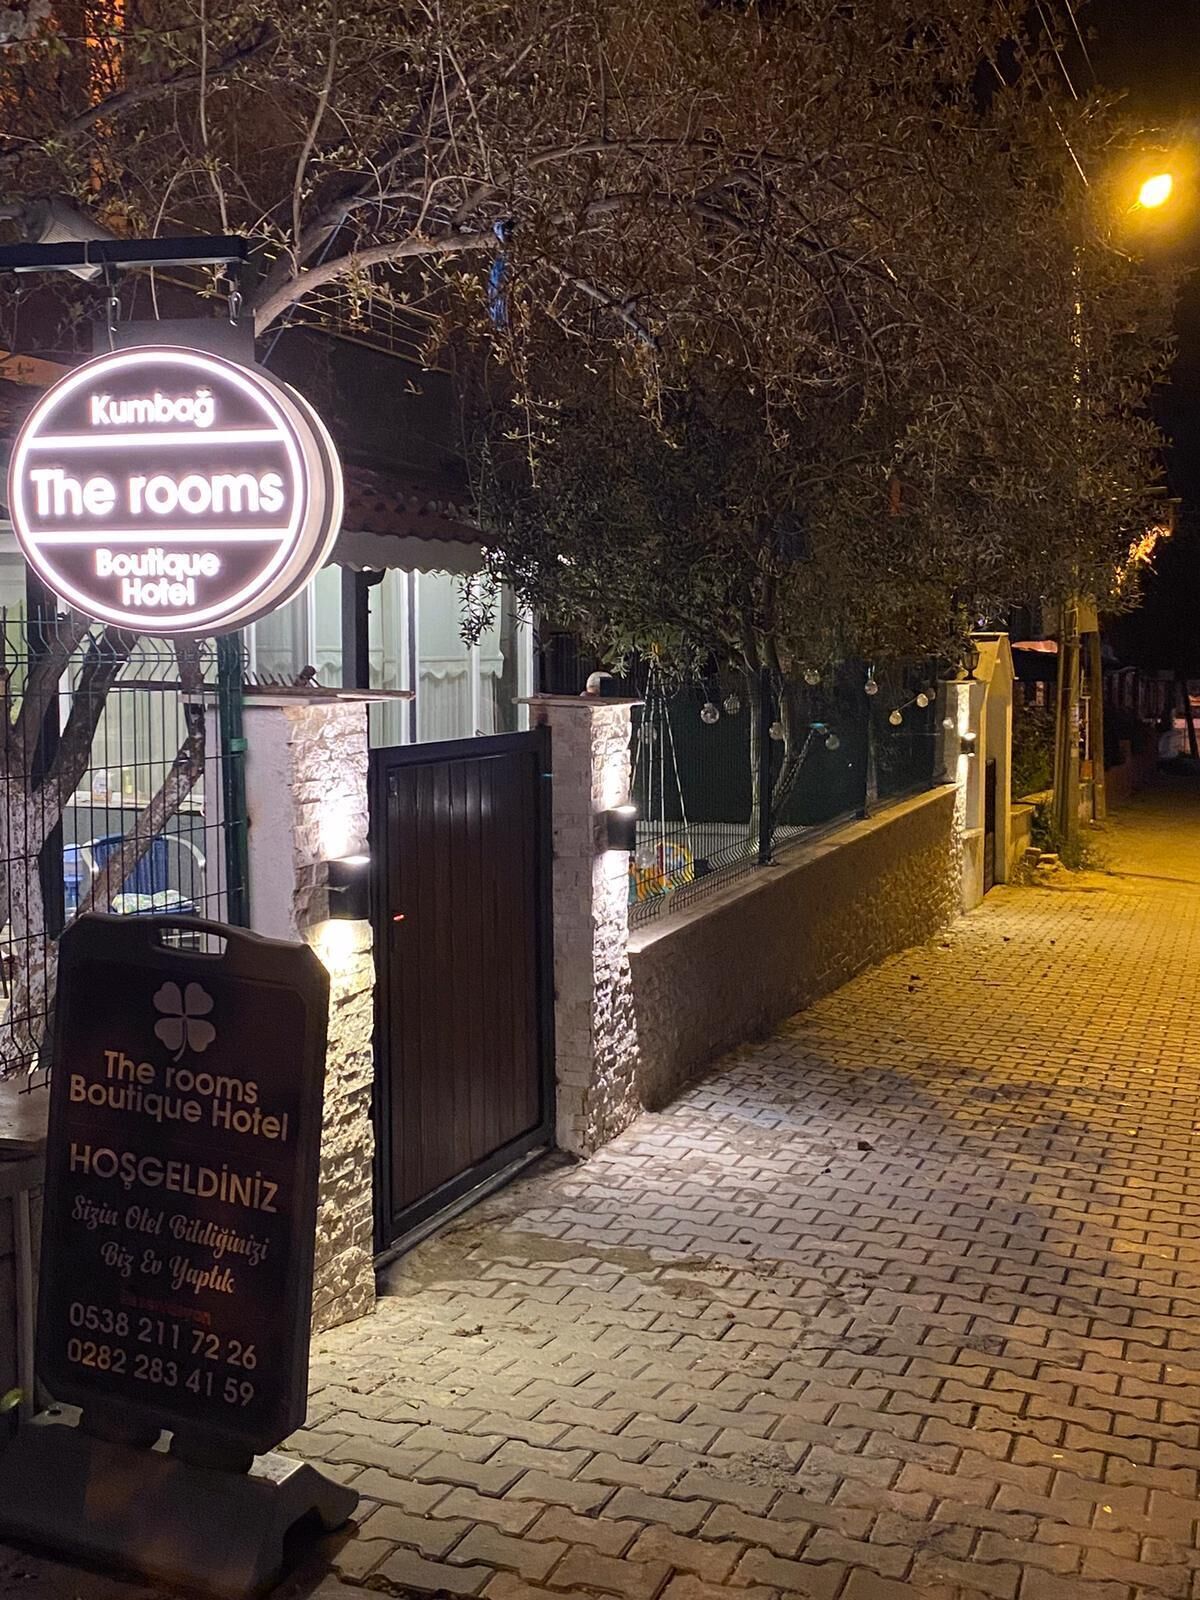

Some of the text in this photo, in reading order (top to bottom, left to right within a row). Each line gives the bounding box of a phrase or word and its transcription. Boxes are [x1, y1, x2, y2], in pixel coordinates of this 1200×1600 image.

[91, 388, 214, 428] Kumbağ
[30, 468, 284, 516] The rooms
[95, 547, 221, 580] Boutique
[122, 577, 196, 606] Hotel
[104, 1050, 258, 1103] The rooms
[70, 1074, 288, 1141] Boutique Hotel
[70, 1143, 279, 1213] HOŞGELDİNİZ
[71, 1195, 270, 1265] Sizin Otel Bildiğinizi
[101, 1241, 235, 1294] Biz Ev Yaptık
[70, 1302, 129, 1336] 0538
[137, 1317, 179, 1349] 211
[192, 1330, 219, 1360] 72
[227, 1340, 257, 1370] 26
[67, 1338, 254, 1407] 0282 283 41 59
